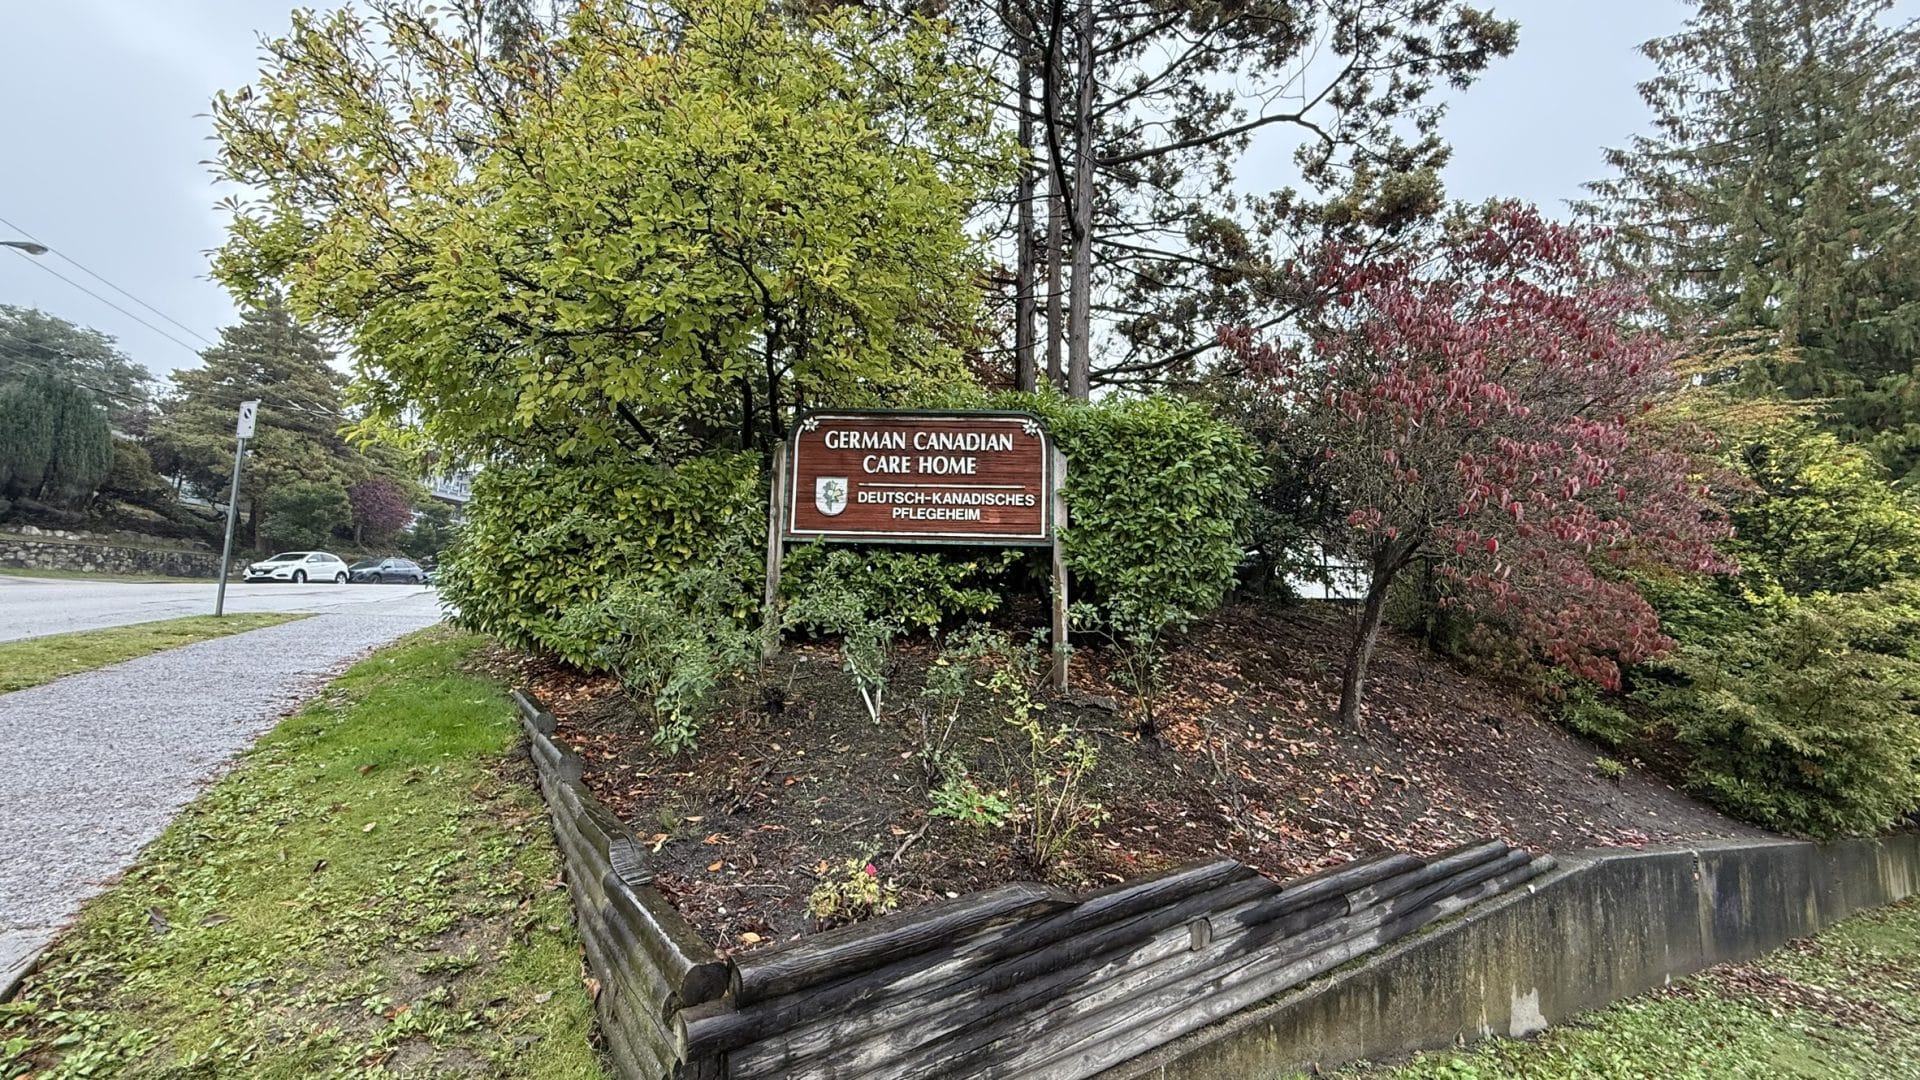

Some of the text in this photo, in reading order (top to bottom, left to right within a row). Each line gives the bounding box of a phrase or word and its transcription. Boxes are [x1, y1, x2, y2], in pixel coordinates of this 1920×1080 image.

[824, 430, 1013, 452] GERMAN CANADIAN
[862, 455, 977, 475] CARE HOME
[858, 491, 1035, 506] DEUTSCH-KANADISCHES
[892, 508, 981, 521] PFLEGEHEIM
